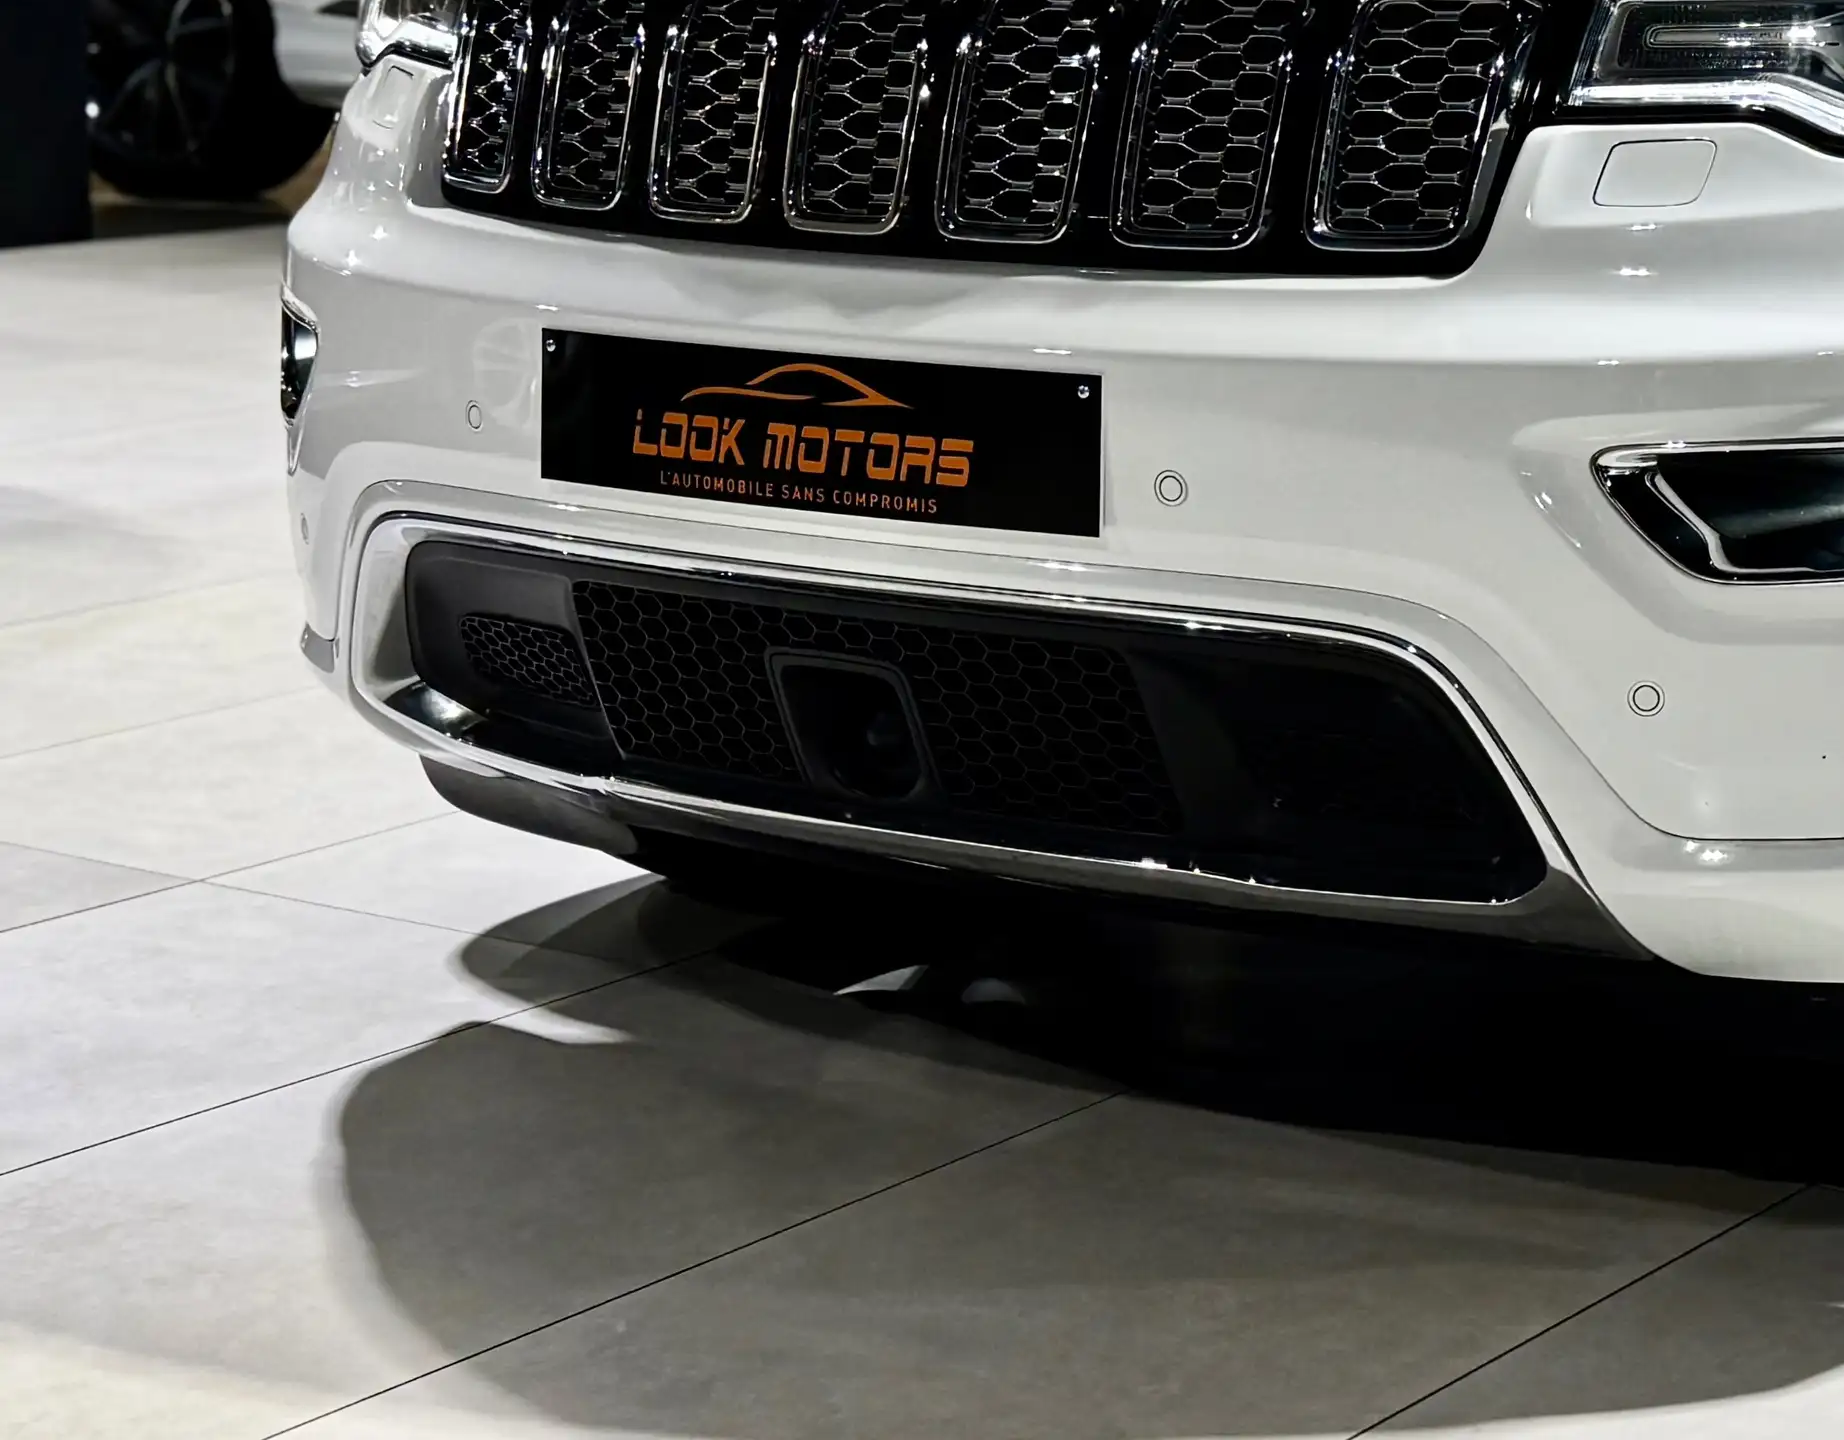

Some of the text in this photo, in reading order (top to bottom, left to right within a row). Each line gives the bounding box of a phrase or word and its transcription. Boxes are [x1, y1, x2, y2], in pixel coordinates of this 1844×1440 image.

[632, 409, 974, 488] LOOK MOTORS
[660, 470, 938, 515] L'AUTOMOBILE SANS COMPROMIS
